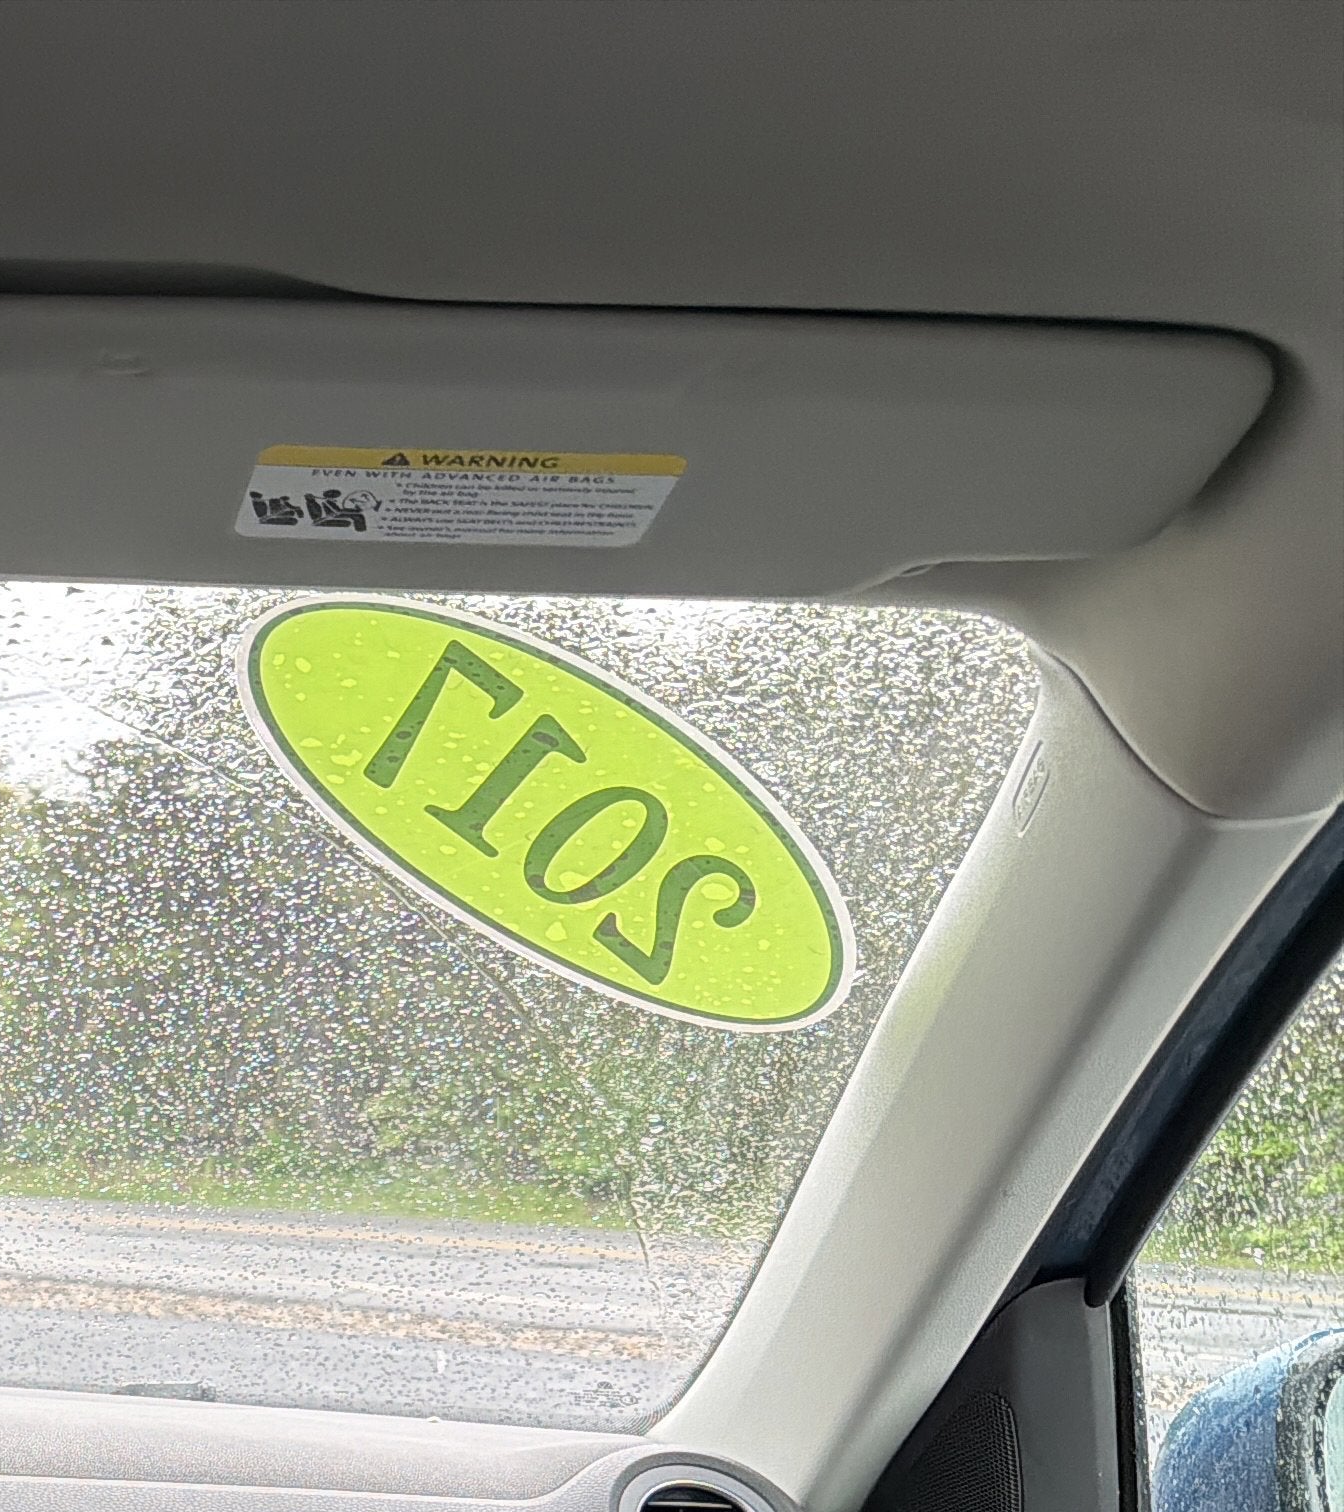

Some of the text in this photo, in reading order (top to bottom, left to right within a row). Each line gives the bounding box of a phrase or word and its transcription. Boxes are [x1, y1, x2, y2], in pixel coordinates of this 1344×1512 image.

[422, 454, 560, 469] WARNING
[312, 469, 615, 484] EVEN WITH ADVANCED AIR BAGS
